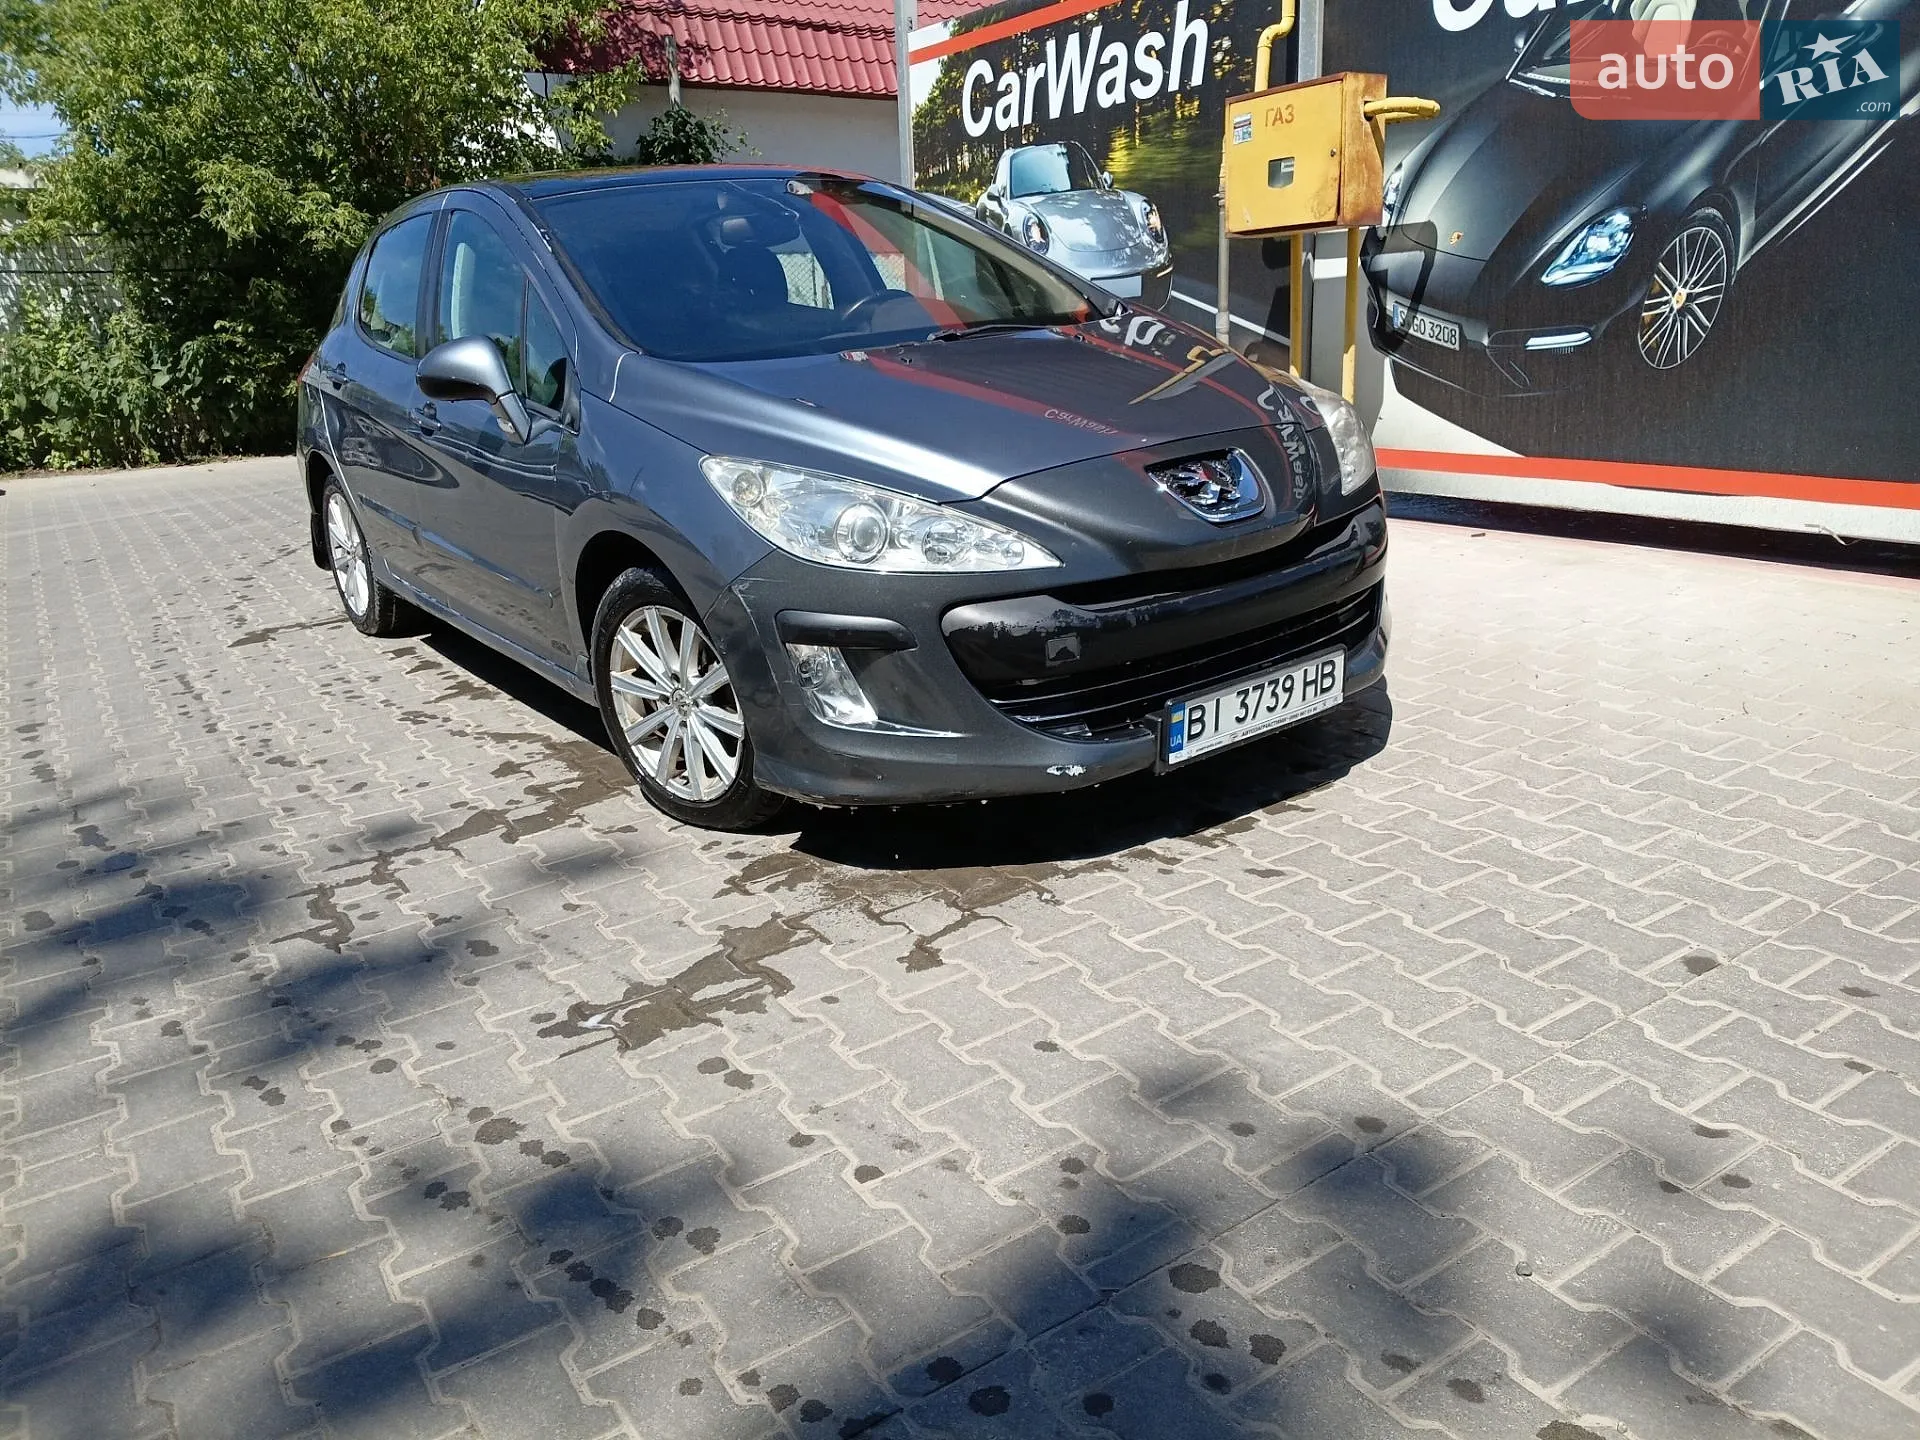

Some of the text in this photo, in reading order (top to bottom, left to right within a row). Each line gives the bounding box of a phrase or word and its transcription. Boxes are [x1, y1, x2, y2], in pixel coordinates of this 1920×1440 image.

[961, 0, 1209, 138] CarWash
[1265, 104, 1295, 127] ГАЗ
[1428, 321, 1457, 346] 3208
[1187, 660, 1336, 742] BI 3739 HB
[1170, 733, 1182, 747] UA
